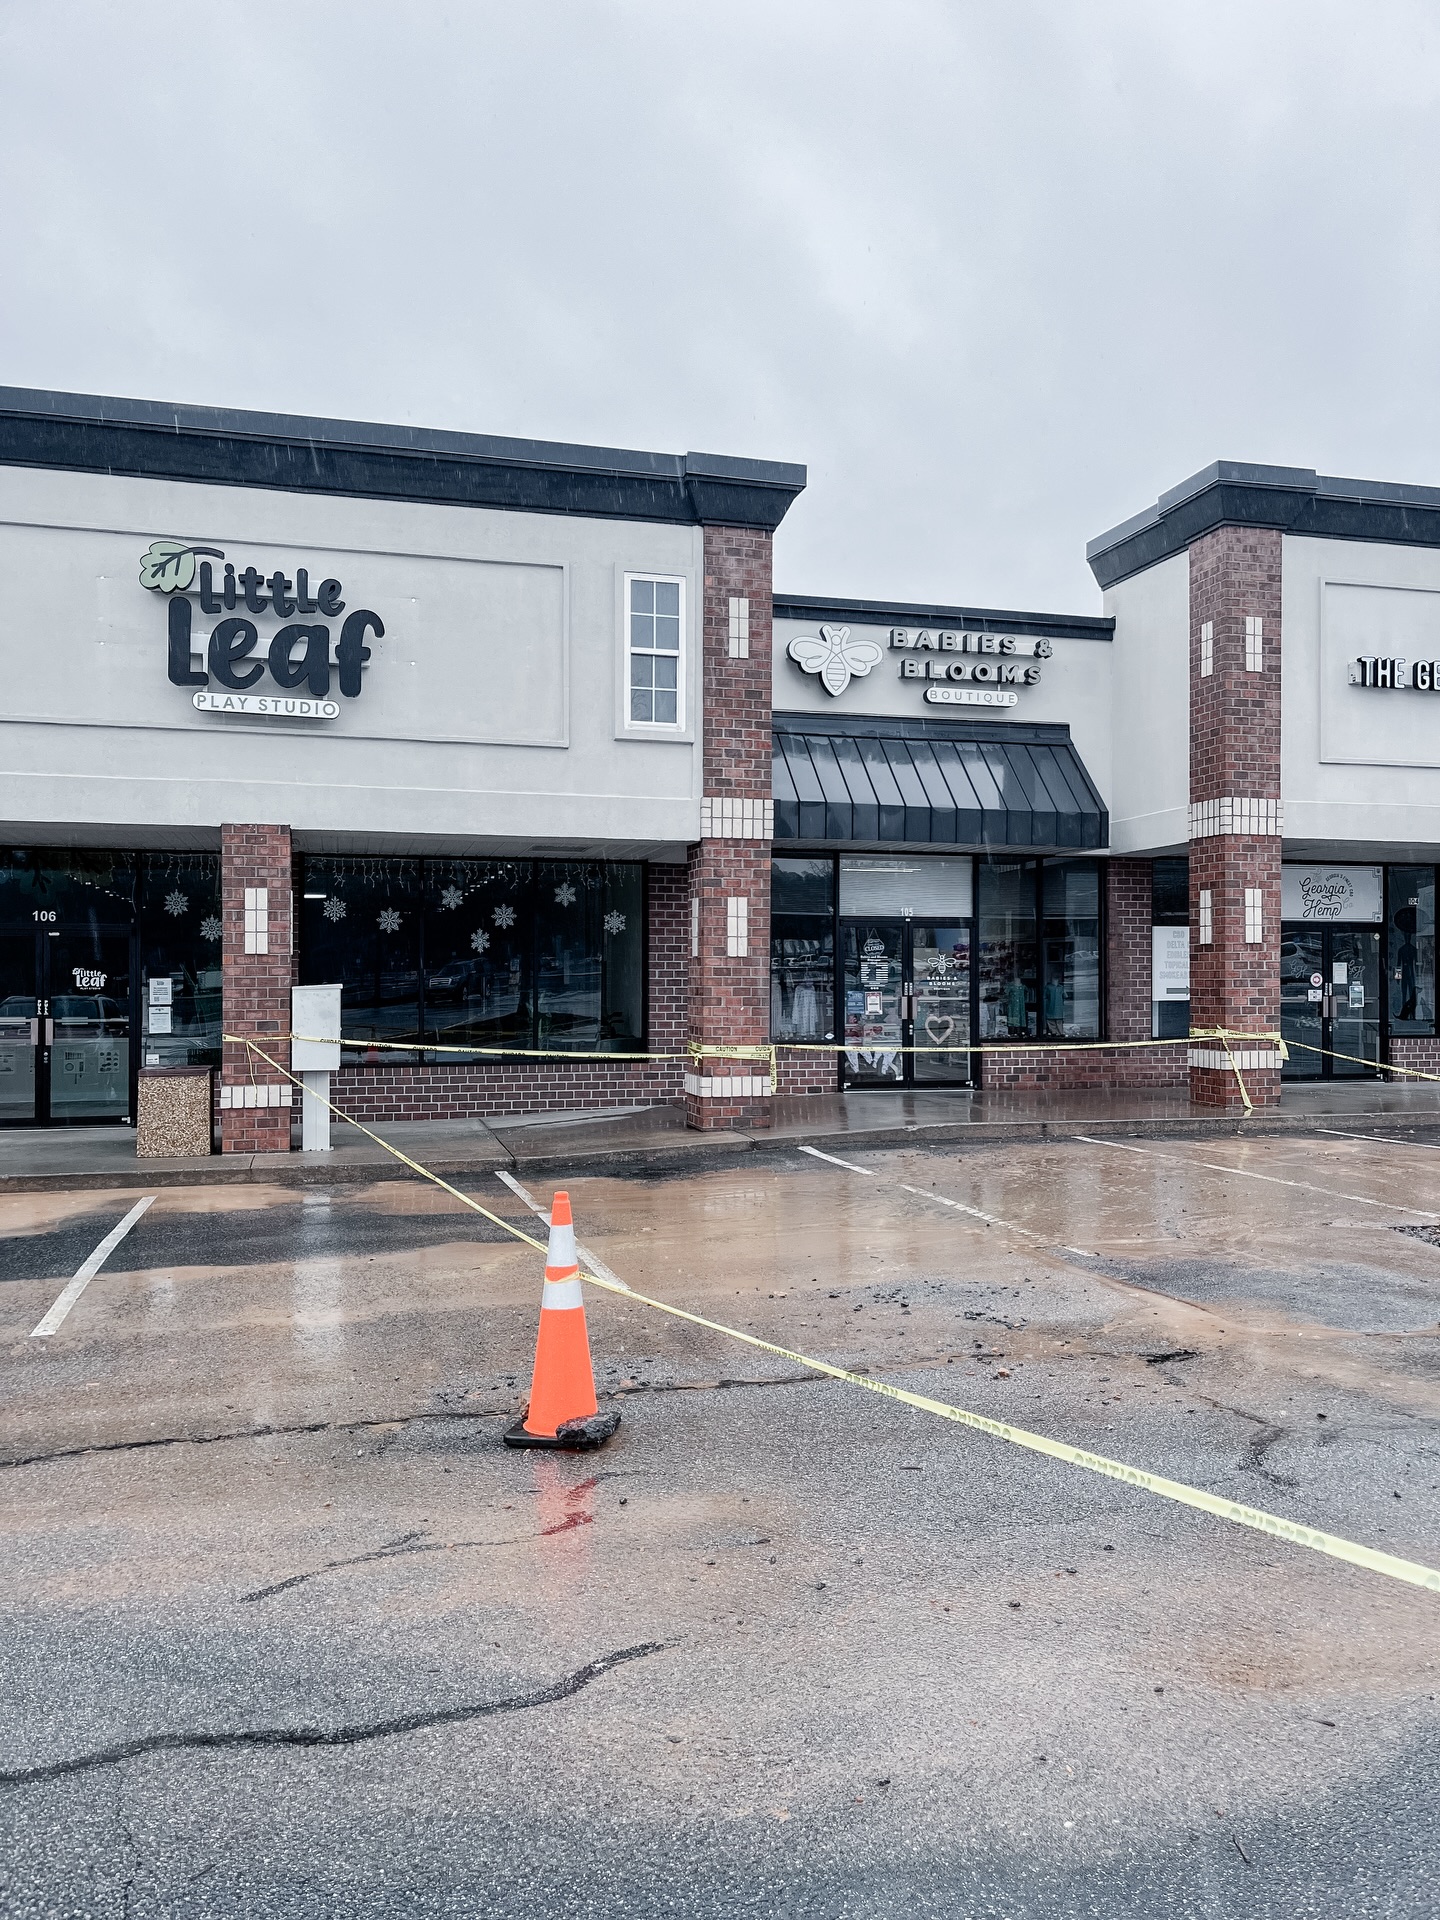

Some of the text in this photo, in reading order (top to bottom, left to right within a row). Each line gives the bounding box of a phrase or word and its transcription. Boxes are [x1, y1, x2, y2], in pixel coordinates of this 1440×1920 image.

[168, 597, 385, 698] Leaf
[890, 628, 1053, 659] BABIES &
[901, 659, 1041, 686] BLOOMS
[1357, 656, 1406, 689] THE
[197, 695, 336, 717] PLAY STUDIO
[929, 691, 1015, 704] BOUTIQUE
[1299, 877, 1347, 901] Georgia
[32, 911, 57, 922] 106
[900, 907, 914, 916] 105
[1302, 899, 1343, 920] Hemp
[1166, 940, 1185, 948] DELTA
[76, 974, 107, 987] Leaf
